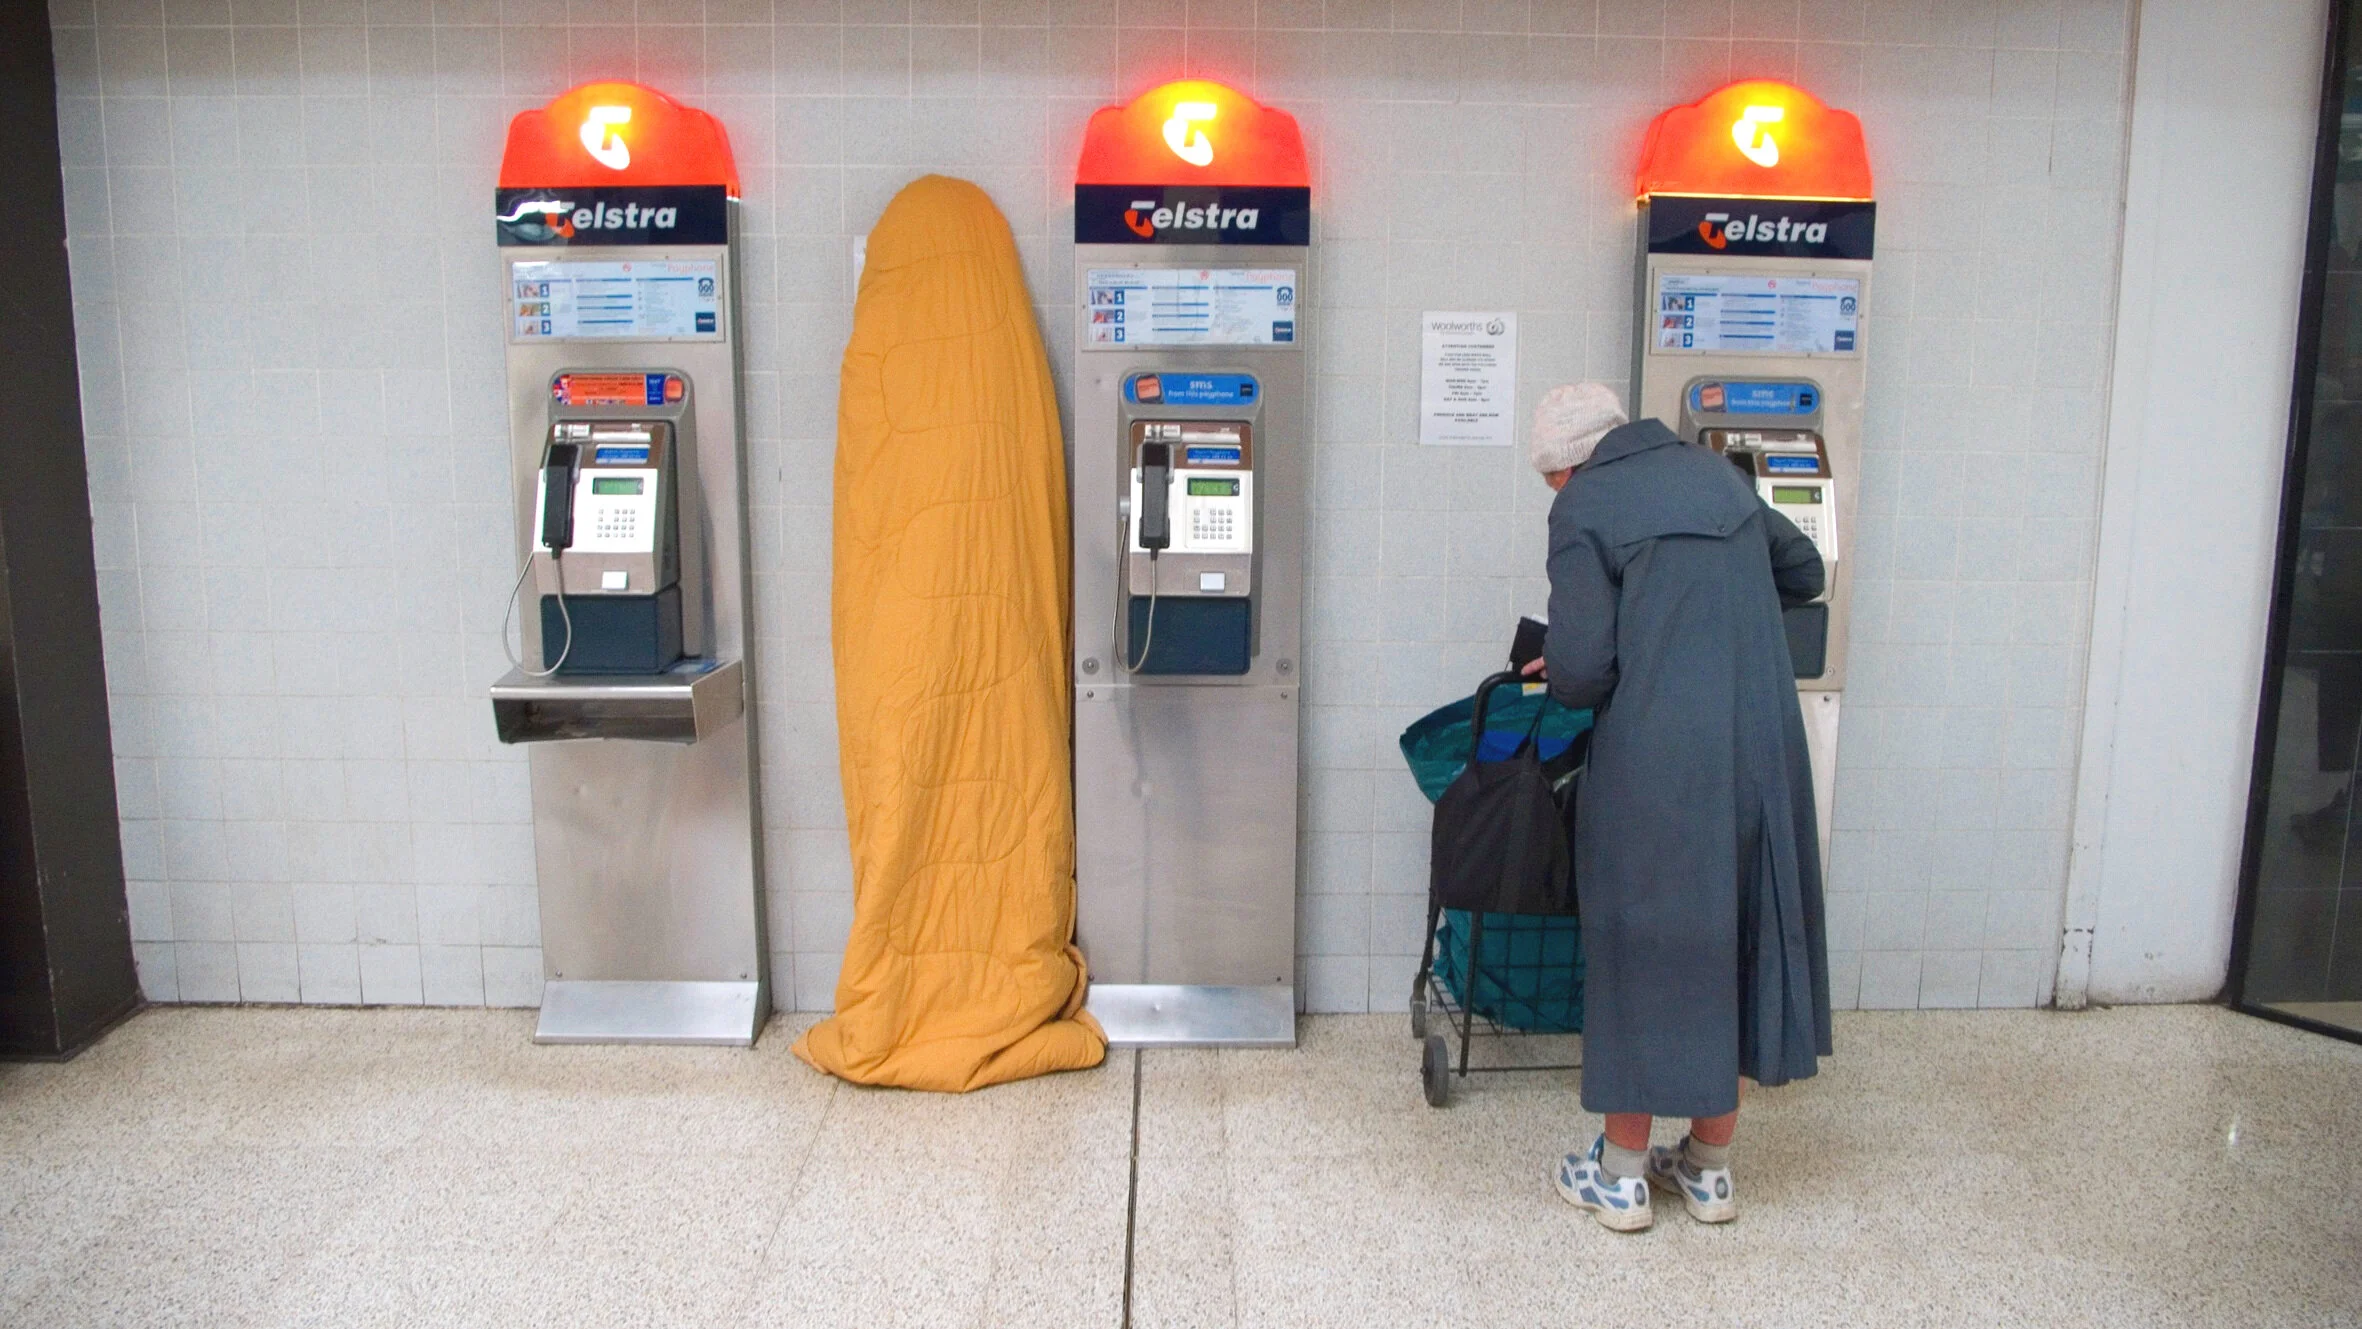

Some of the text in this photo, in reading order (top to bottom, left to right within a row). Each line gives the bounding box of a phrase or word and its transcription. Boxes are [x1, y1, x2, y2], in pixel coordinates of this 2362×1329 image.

[545, 201, 677, 238] Telstra
[1123, 200, 1260, 238] Telstra
[1698, 213, 1828, 249] Telstra
[1277, 293, 1293, 302] 000
[1431, 321, 1483, 332] Woolworths
[1189, 380, 1213, 390] sms
[1199, 390, 1234, 399] payphone
